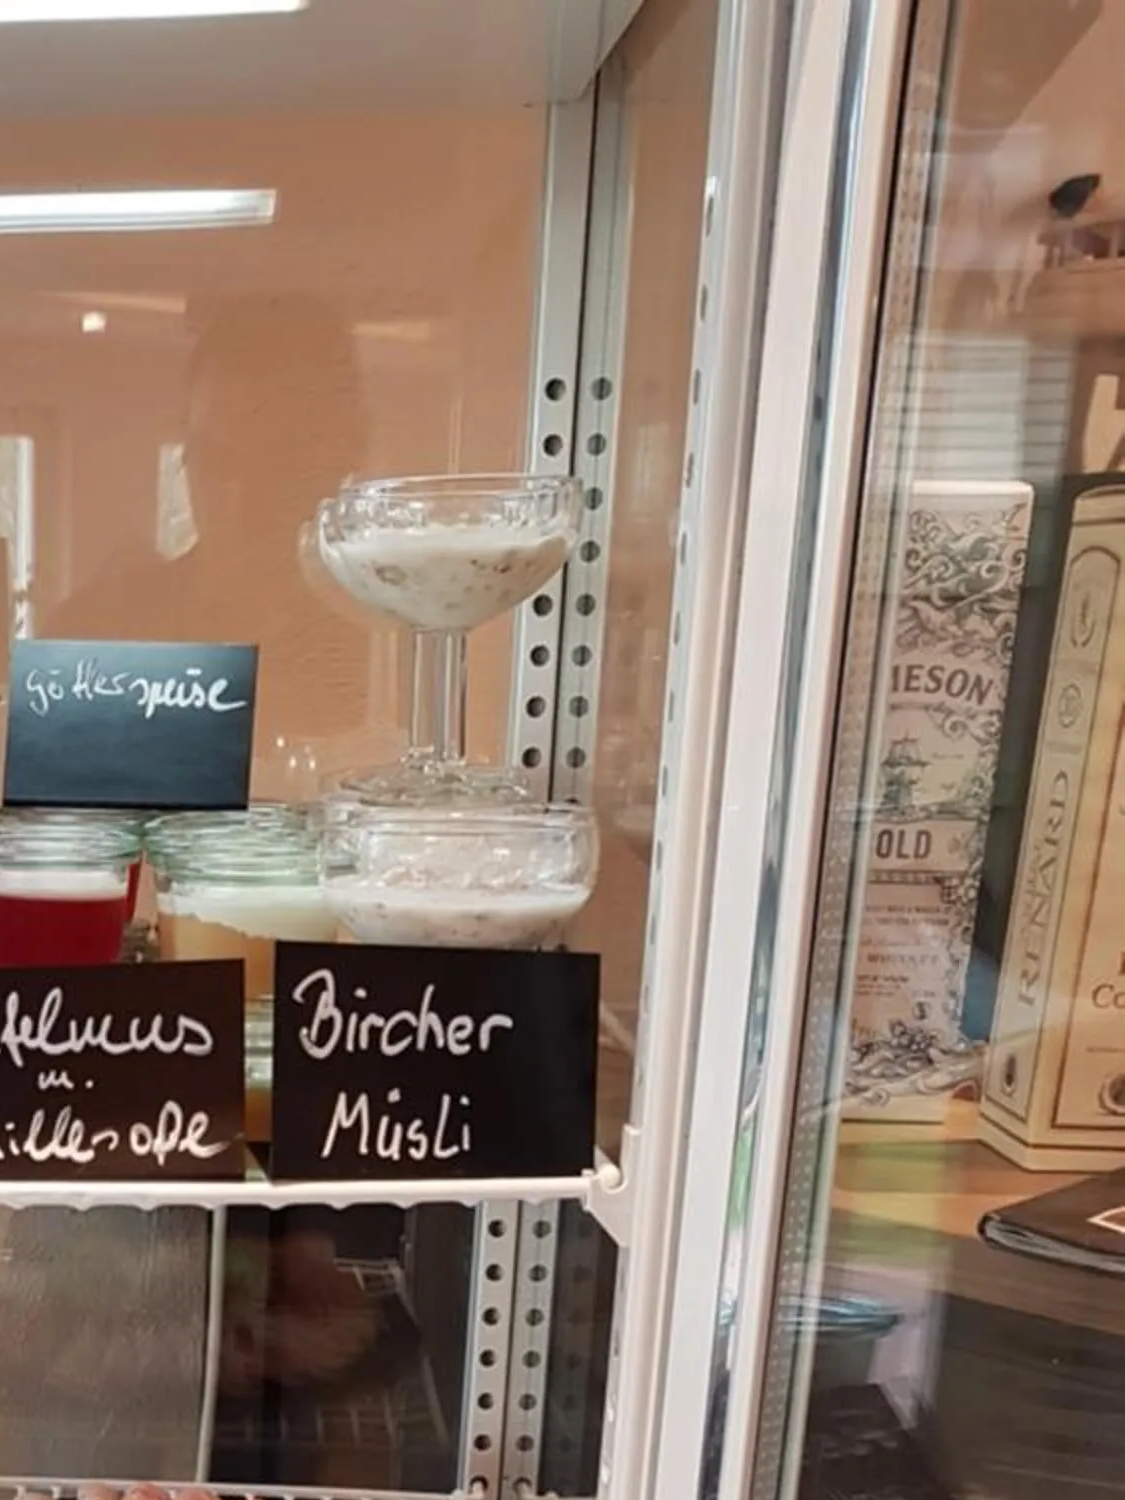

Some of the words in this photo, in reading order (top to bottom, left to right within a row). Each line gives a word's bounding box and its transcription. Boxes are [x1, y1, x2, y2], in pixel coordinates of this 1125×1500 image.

[891, 663, 995, 706] ESON
[875, 828, 932, 860] OLD
[292, 967, 514, 1060] Bircher
